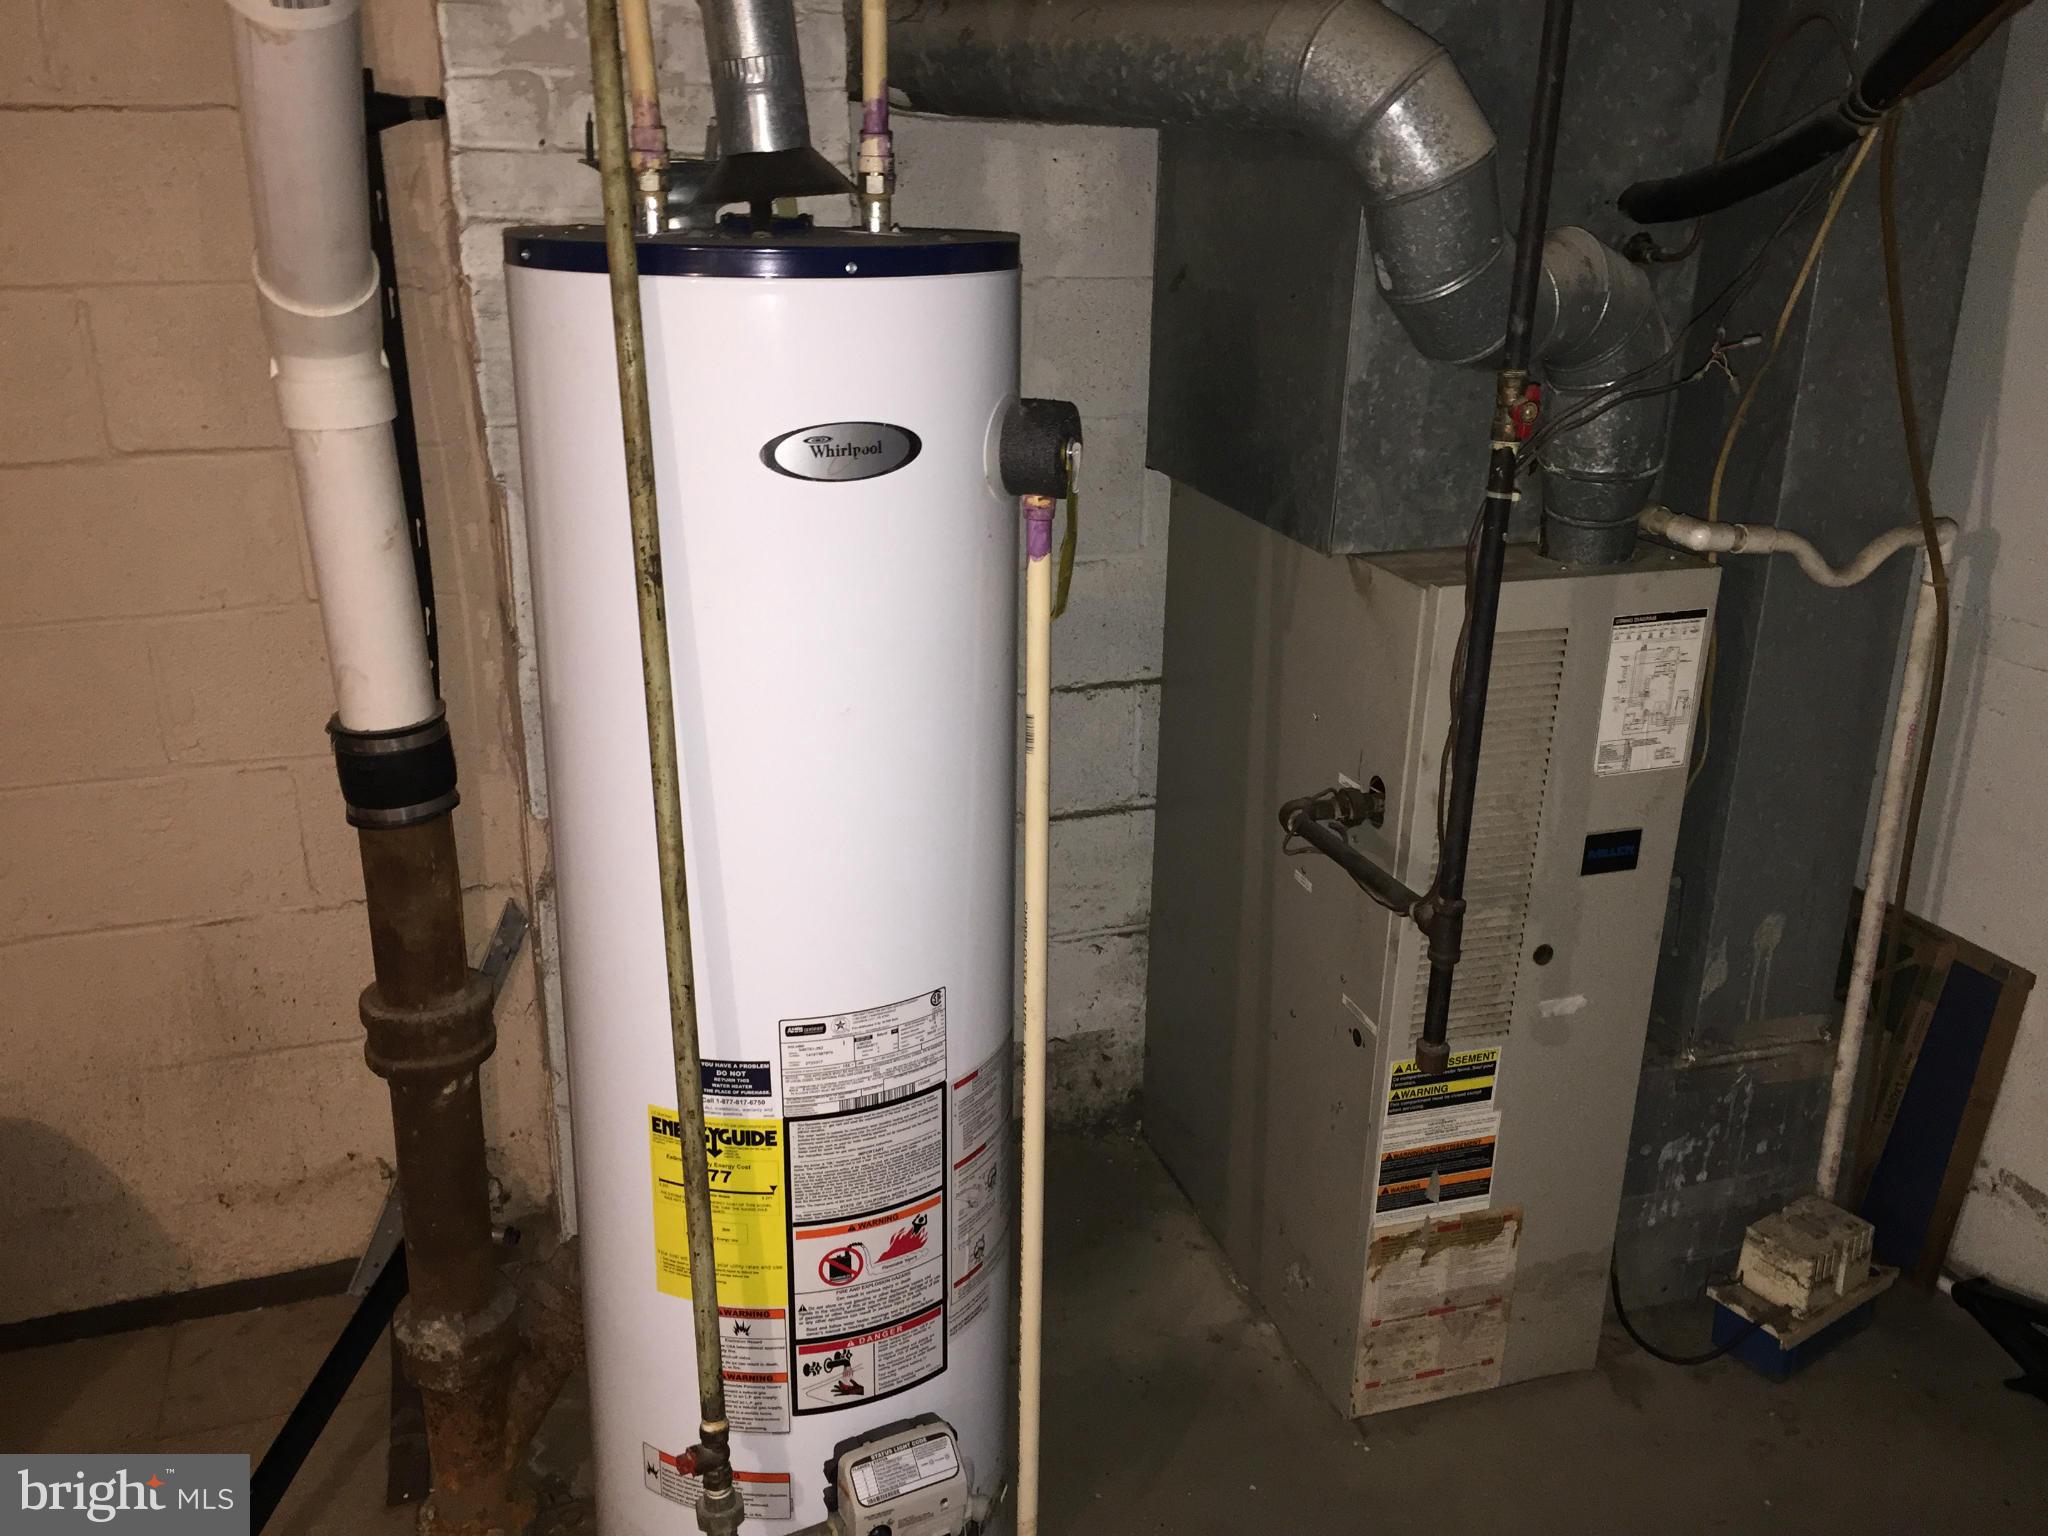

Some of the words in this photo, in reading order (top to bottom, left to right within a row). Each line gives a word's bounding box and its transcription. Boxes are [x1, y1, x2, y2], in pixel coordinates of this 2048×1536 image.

[810, 440, 883, 460] Whirlpool
[716, 1069, 728, 1077] DO
[1400, 1085, 1449, 1099] WARNING
[714, 1162, 735, 1170] Energy
[1391, 1183, 1421, 1194] WARNING
[857, 1213, 899, 1230] WARNING
[723, 1309, 771, 1318] WARNING
[858, 1326, 903, 1345] DANGER
[726, 1373, 774, 1382] WARNING
[870, 1449, 893, 1460] STATUS
[894, 1441, 911, 1453] LIGHT
[911, 1437, 928, 1447] CODE
